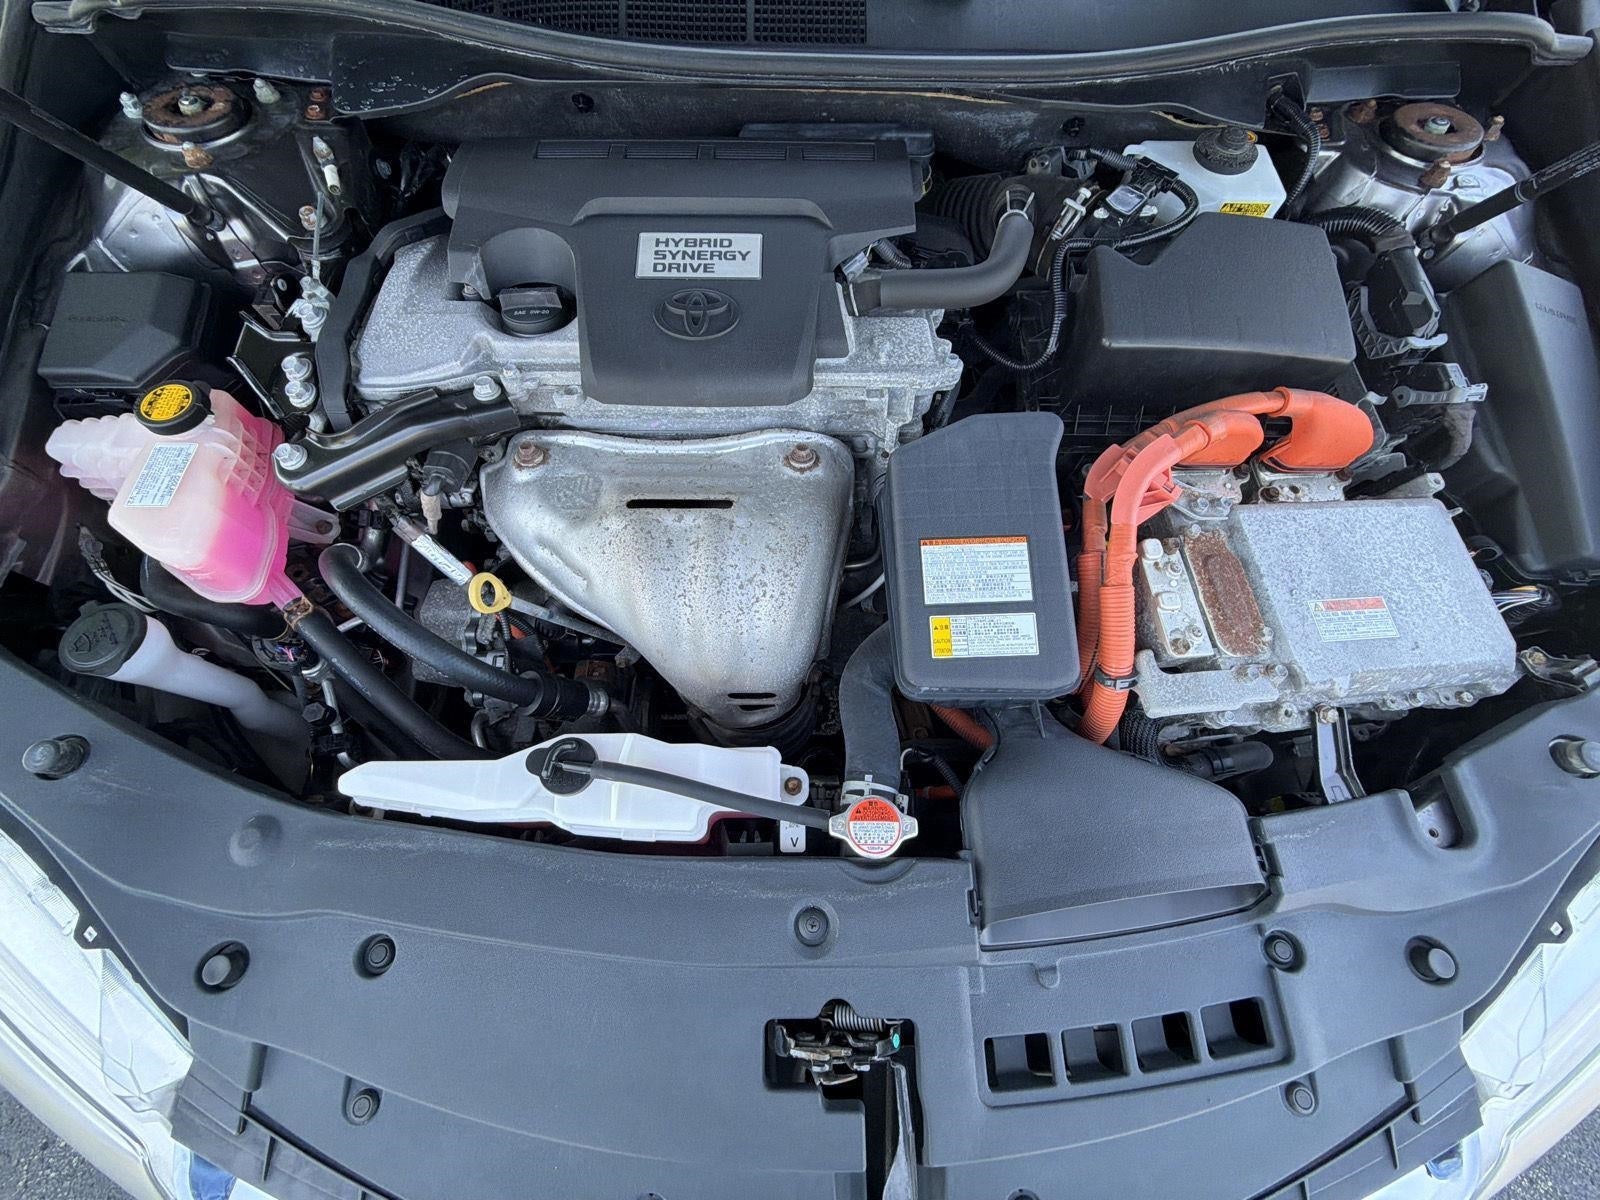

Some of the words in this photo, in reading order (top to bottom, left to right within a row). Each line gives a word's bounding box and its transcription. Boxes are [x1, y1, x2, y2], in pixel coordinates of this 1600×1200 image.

[655, 238, 733, 248] HYBRID
[653, 250, 751, 261] SYNERGY
[652, 262, 715, 273] DRIVE
[790, 836, 799, 848] V
